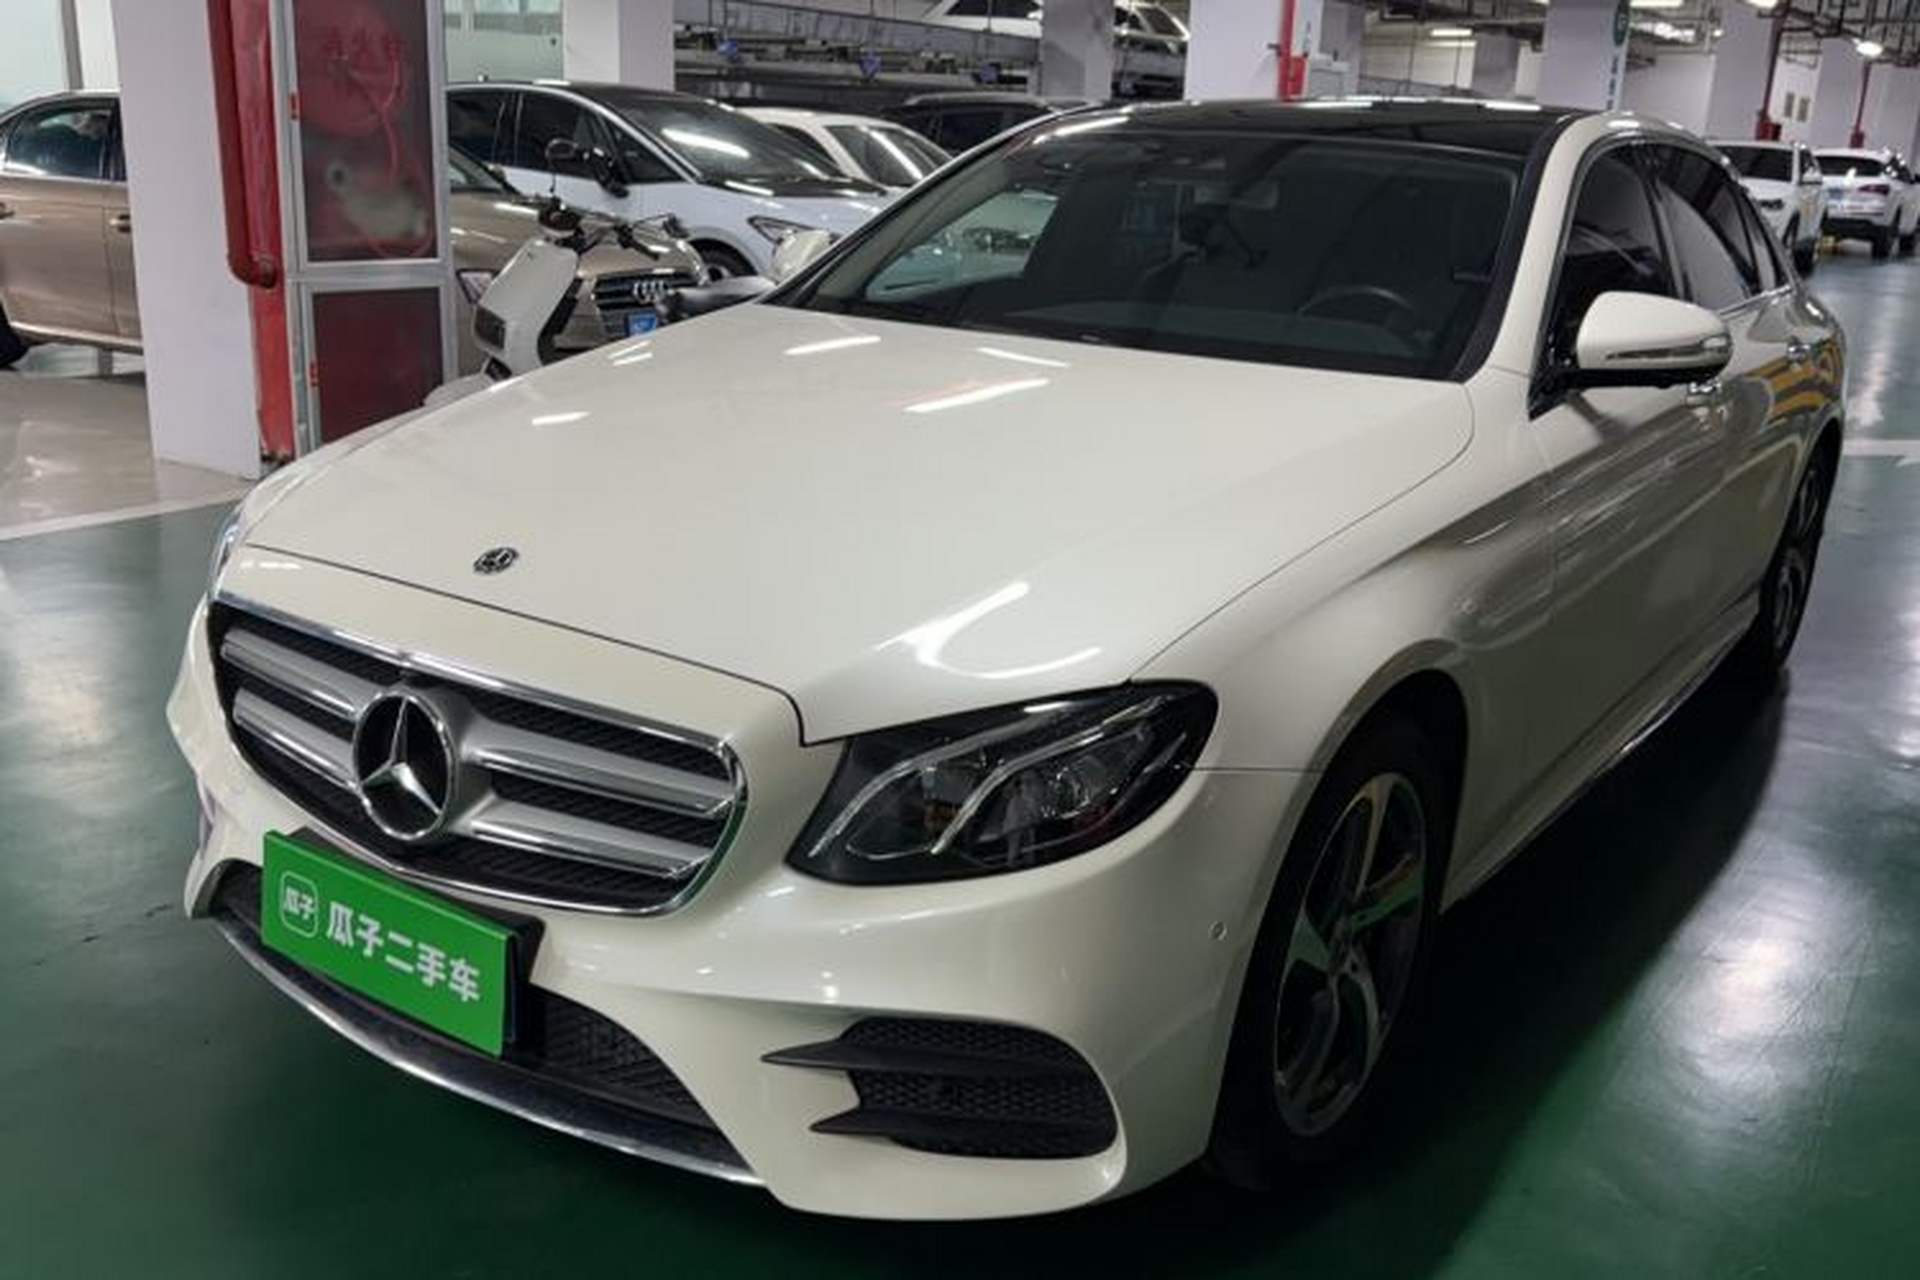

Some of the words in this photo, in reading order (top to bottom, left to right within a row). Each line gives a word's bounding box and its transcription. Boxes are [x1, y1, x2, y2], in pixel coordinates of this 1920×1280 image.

[326, 901, 480, 1002] 瓜子二手车
